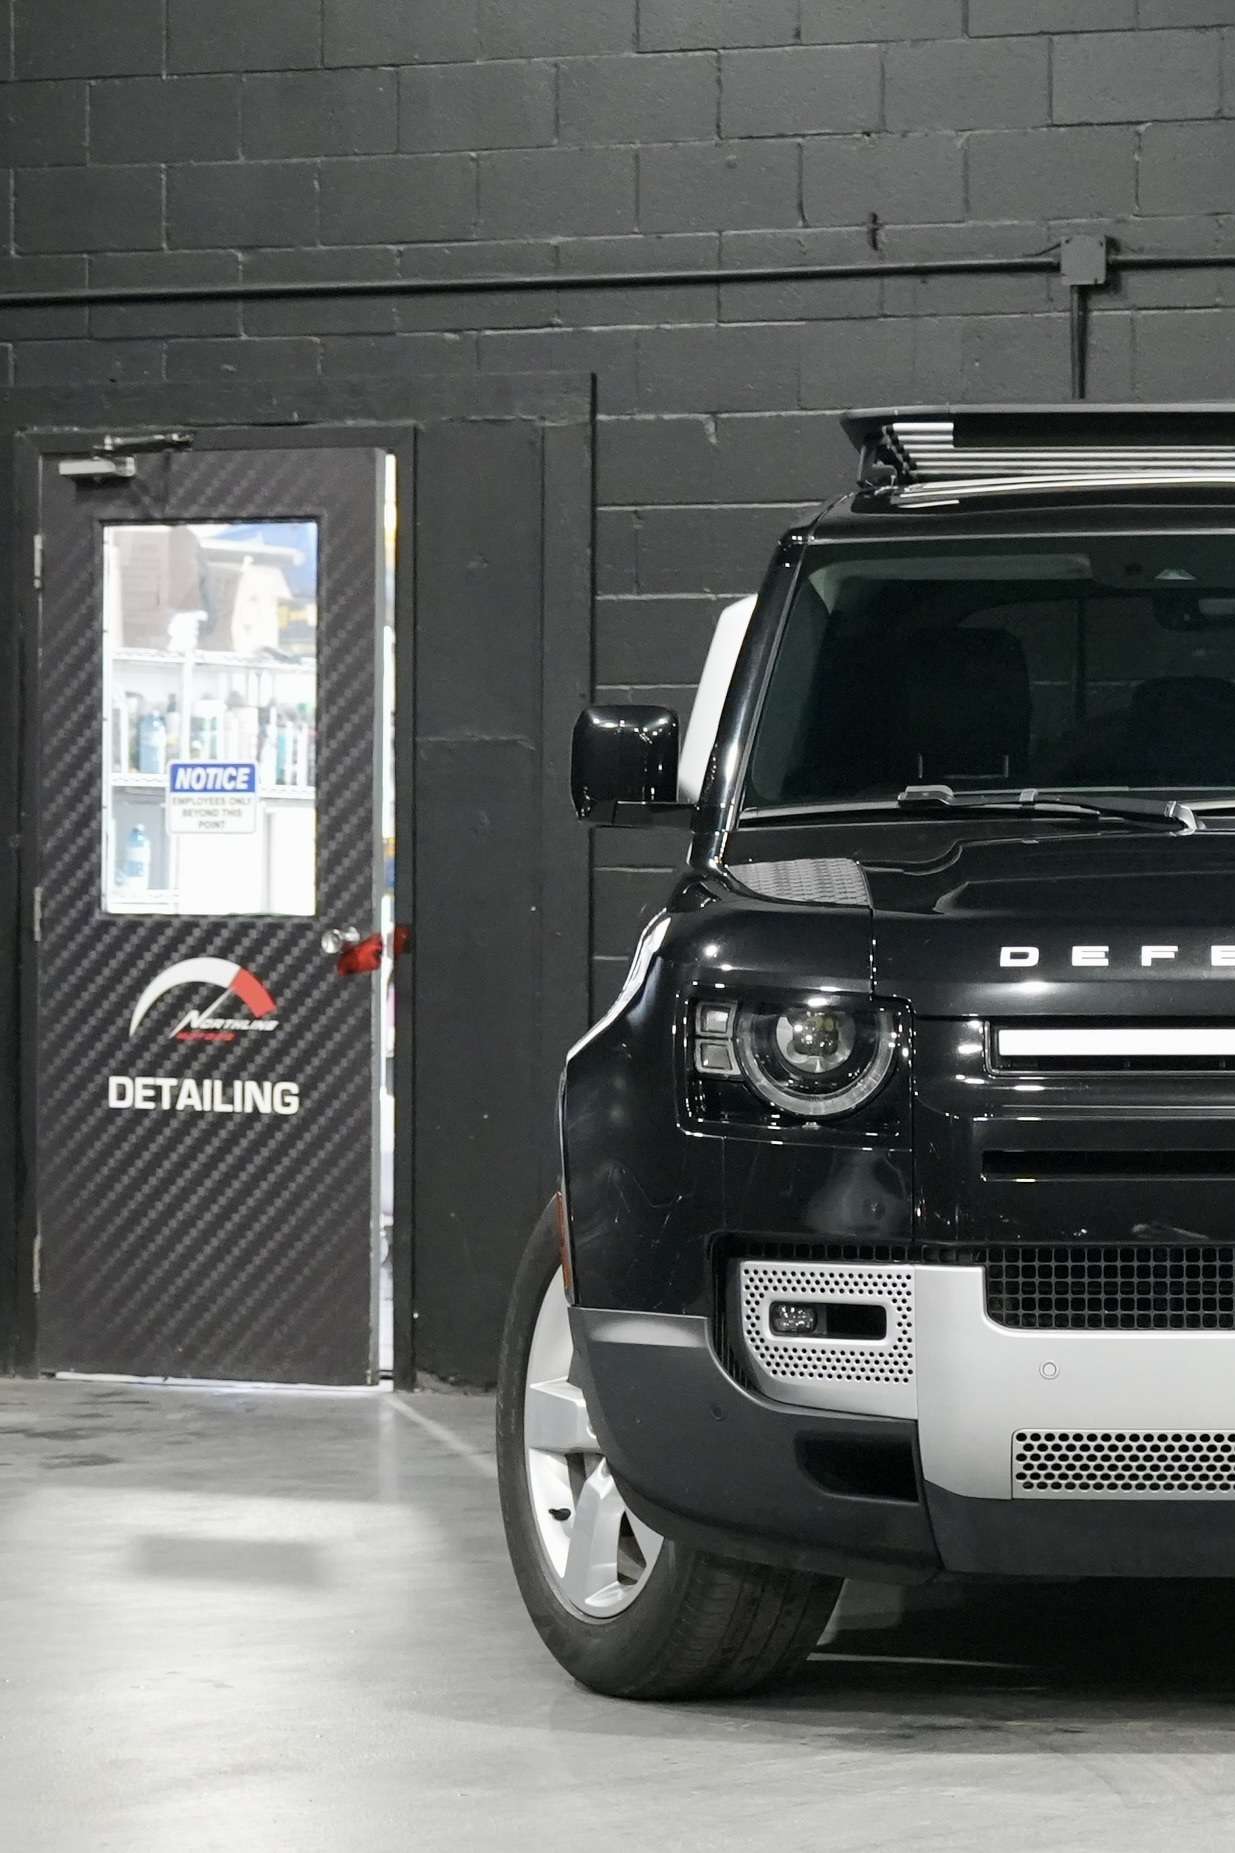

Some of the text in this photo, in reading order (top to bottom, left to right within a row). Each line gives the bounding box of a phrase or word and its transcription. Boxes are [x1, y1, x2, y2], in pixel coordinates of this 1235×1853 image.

[175, 767, 251, 790] NOTICE
[172, 797, 251, 805] EMPLOYEES ONLY
[182, 808, 242, 817] BEYOND THIS
[198, 820, 225, 829] POINT
[108, 1076, 300, 1115] DETAILING
